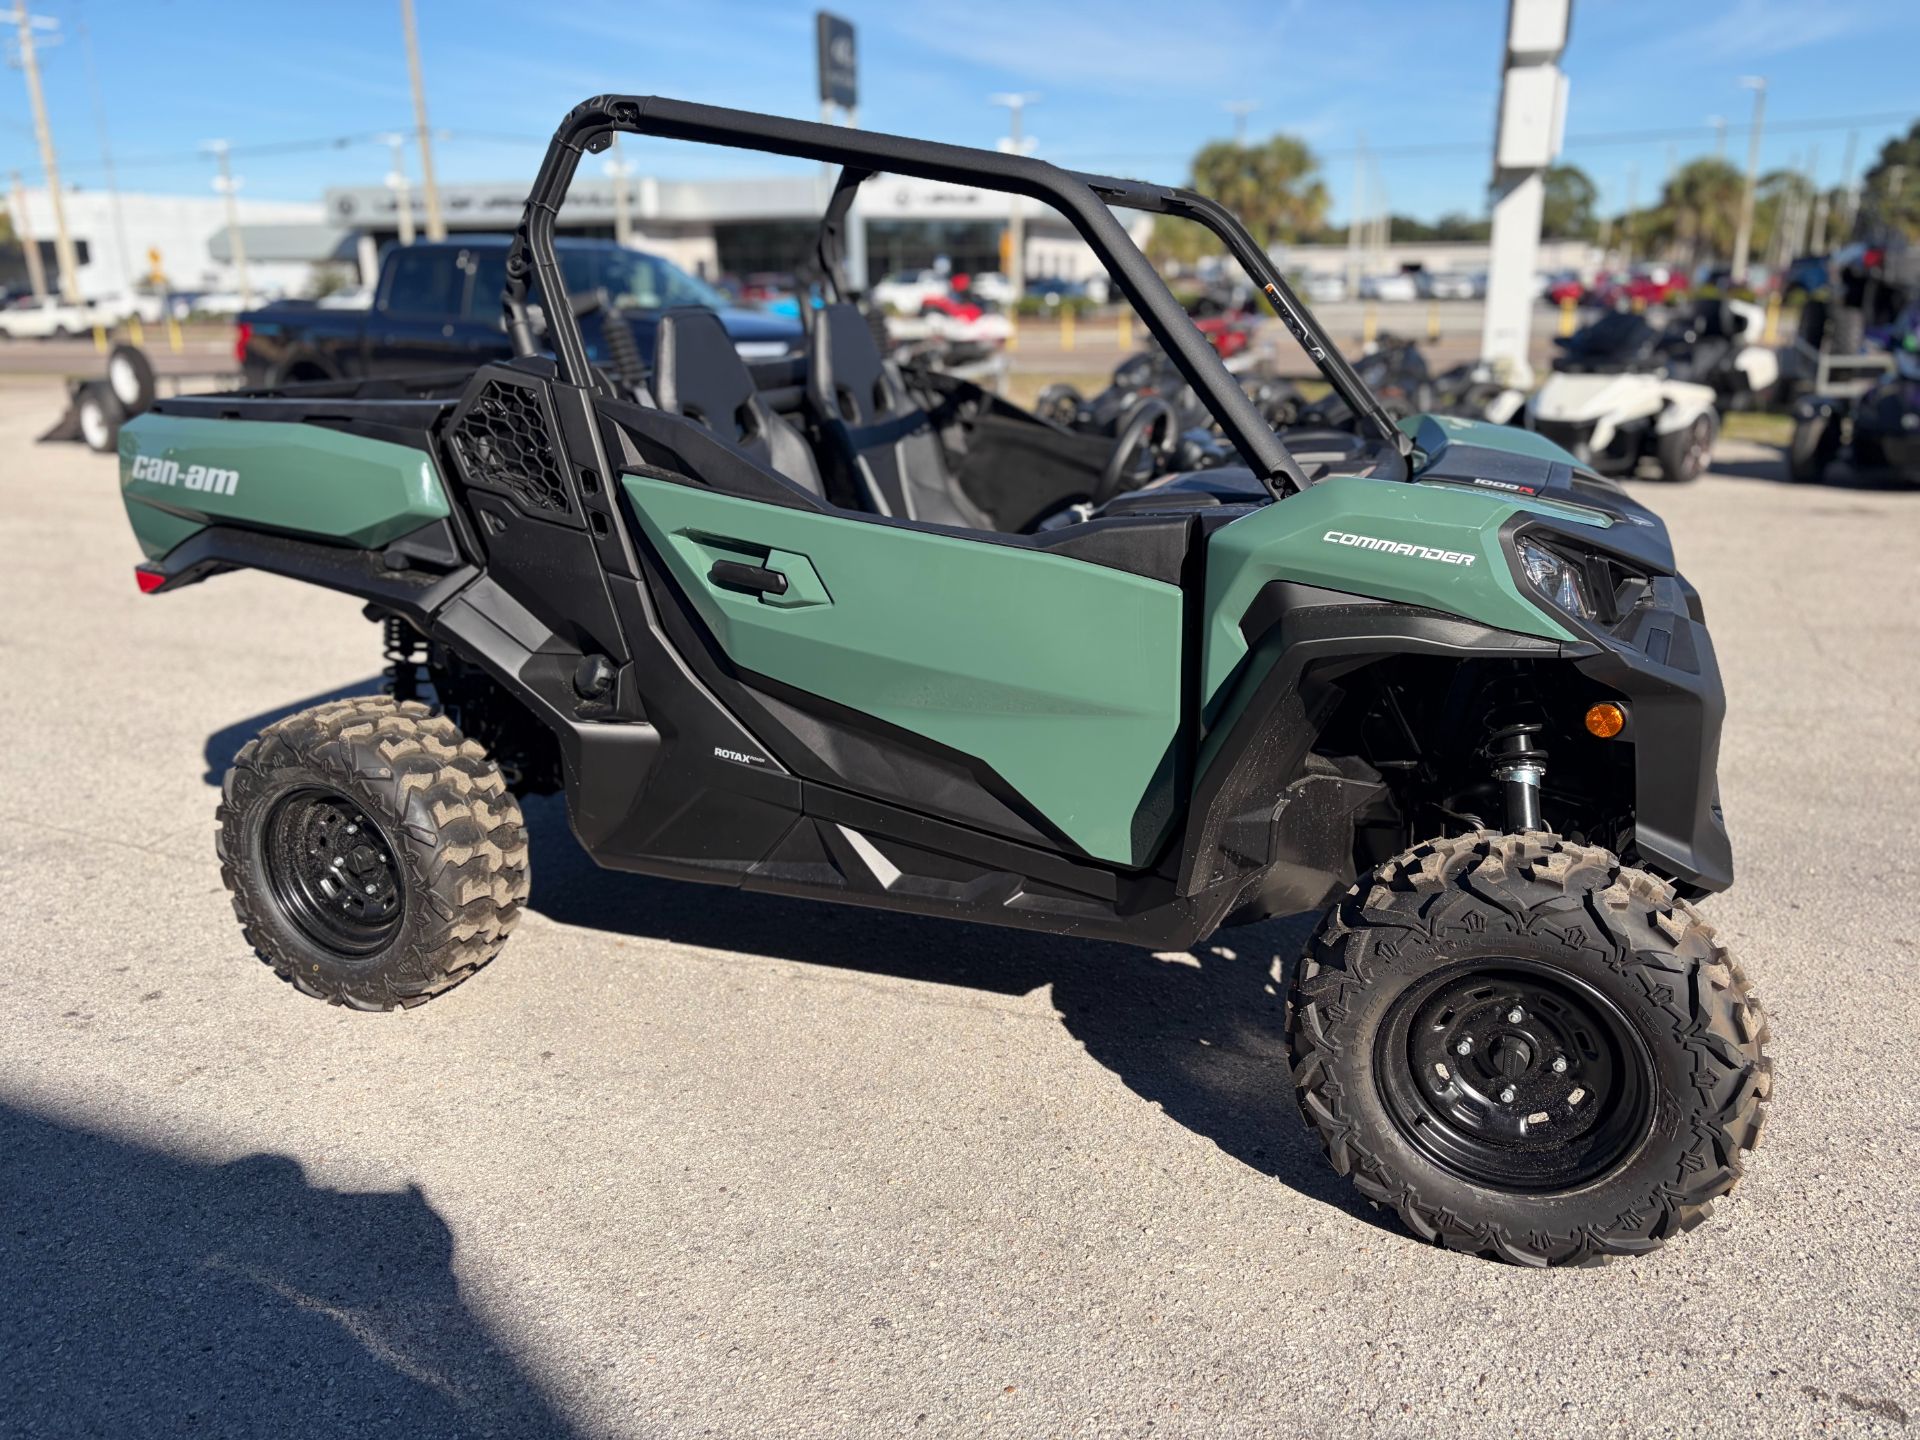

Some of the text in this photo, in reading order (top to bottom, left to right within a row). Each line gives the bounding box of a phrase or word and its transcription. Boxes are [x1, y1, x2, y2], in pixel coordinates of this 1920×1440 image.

[132, 454, 239, 496] can-am
[1474, 478, 1534, 494] 1000R
[1323, 530, 1476, 566] COMMANDER
[714, 747, 750, 763] ROTAX
